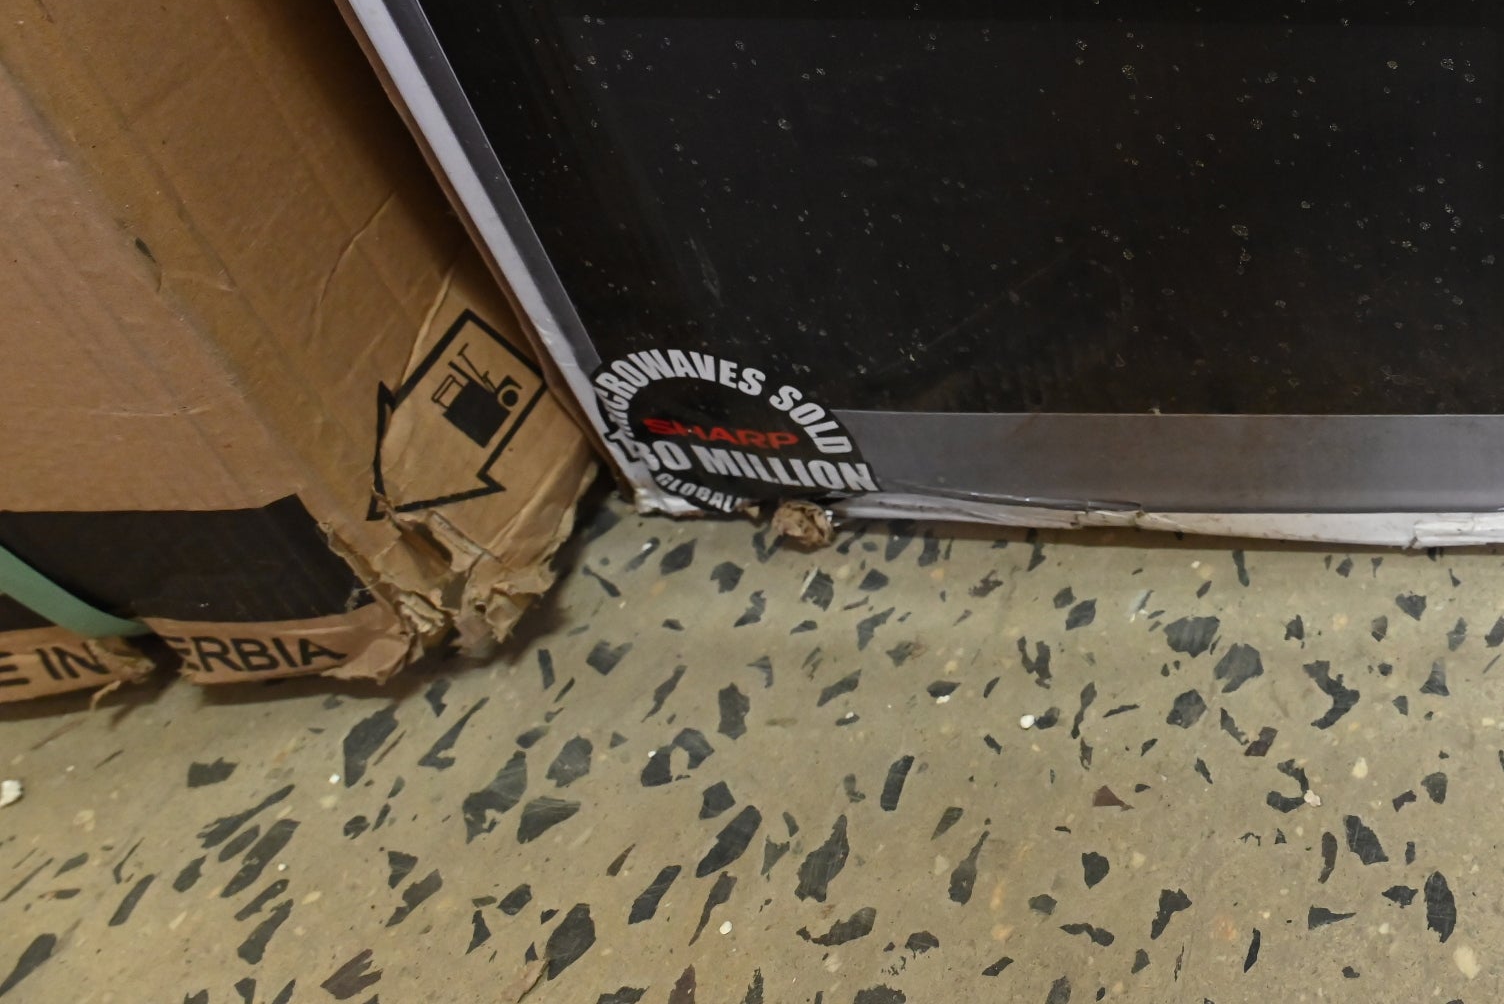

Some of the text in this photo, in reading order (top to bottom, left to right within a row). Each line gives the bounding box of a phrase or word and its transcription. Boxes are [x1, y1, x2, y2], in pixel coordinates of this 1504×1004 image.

[642, 417, 800, 450] SHARP
[769, 385, 853, 454] SOLD
[690, 445, 879, 492] MILLION
[36, 642, 110, 681] IN
